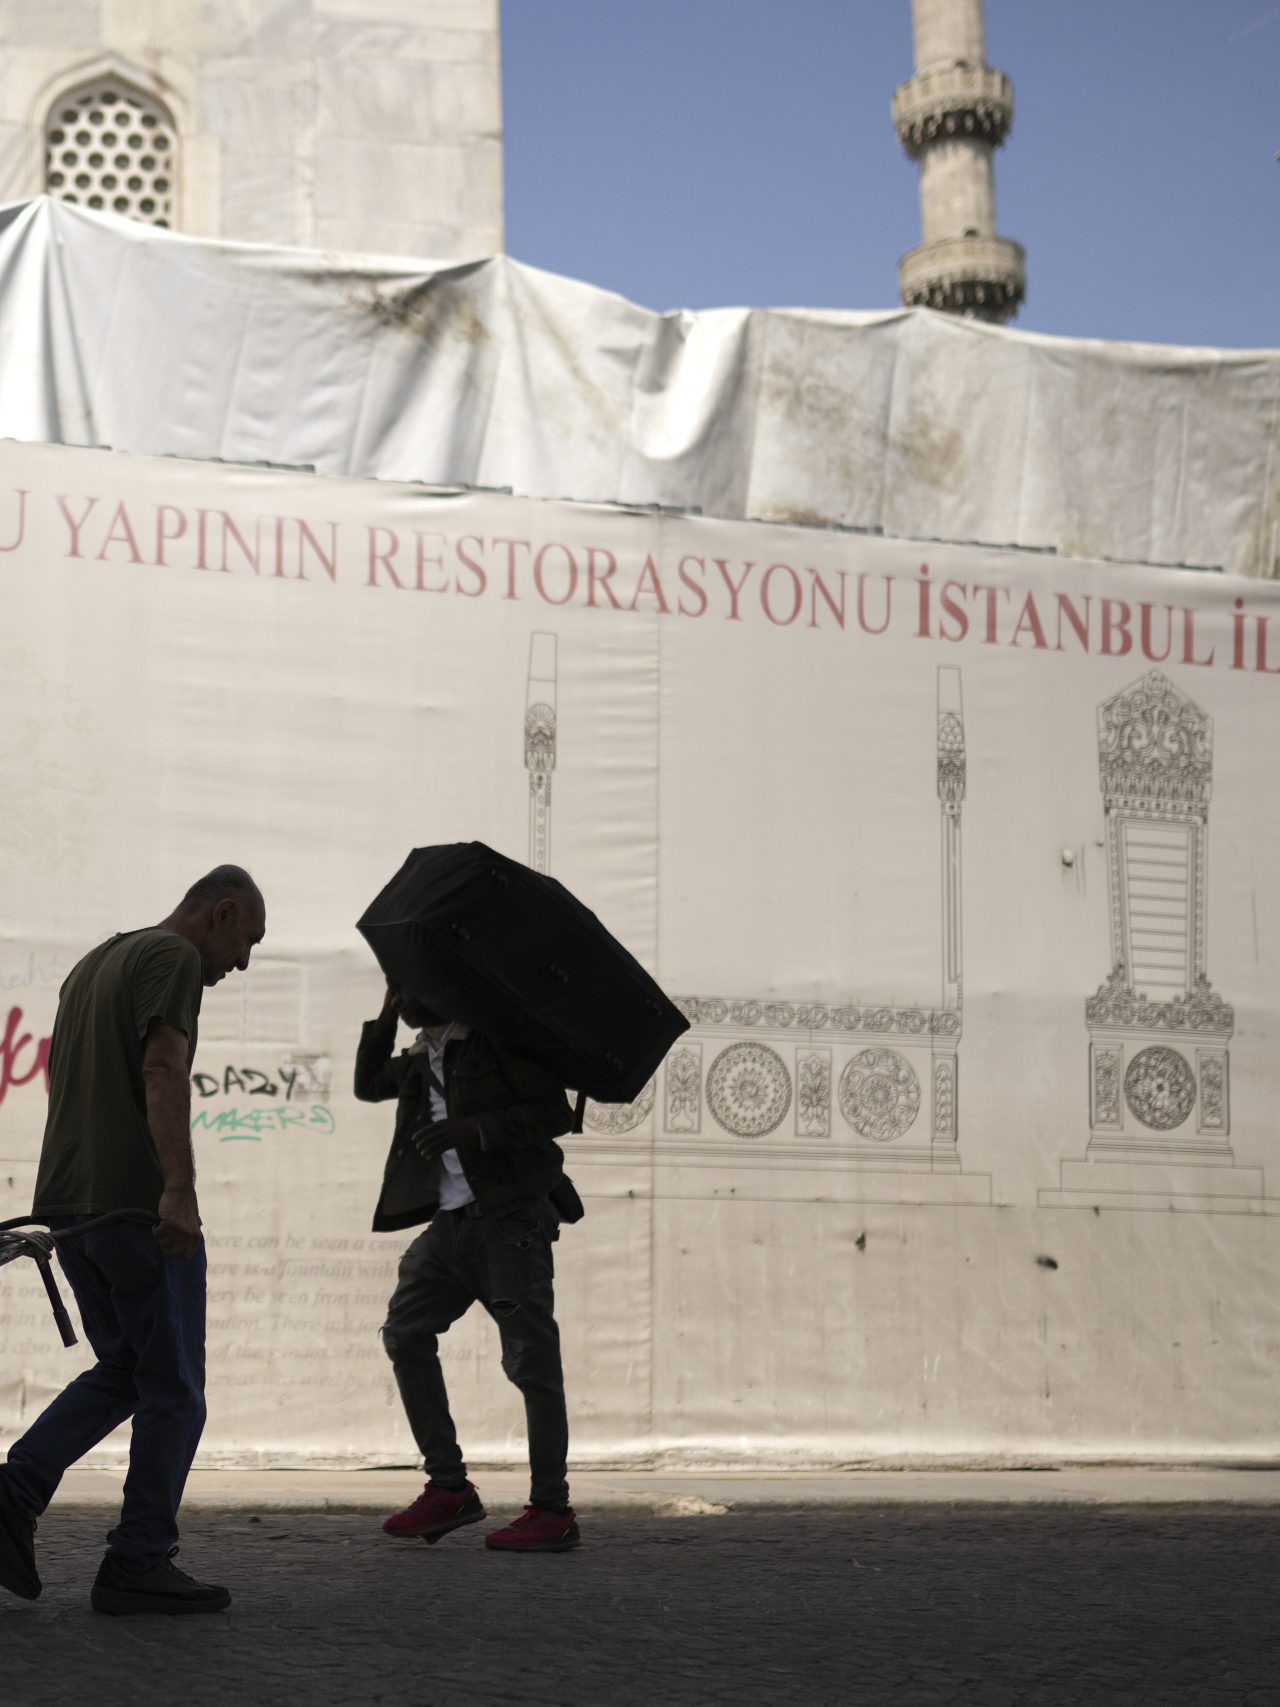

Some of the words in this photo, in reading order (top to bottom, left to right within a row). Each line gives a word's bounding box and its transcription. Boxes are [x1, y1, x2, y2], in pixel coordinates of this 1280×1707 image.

[57, 495, 342, 584] YAPININ
[364, 525, 896, 635] RESTORASYONU
[915, 563, 1215, 667] İSTANBUL
[247, 1235, 280, 1249] can
[285, 1231, 306, 1250] be
[310, 1237, 348, 1251] seen
[352, 1239, 365, 1251] a
[243, 1285, 267, 1304] be
